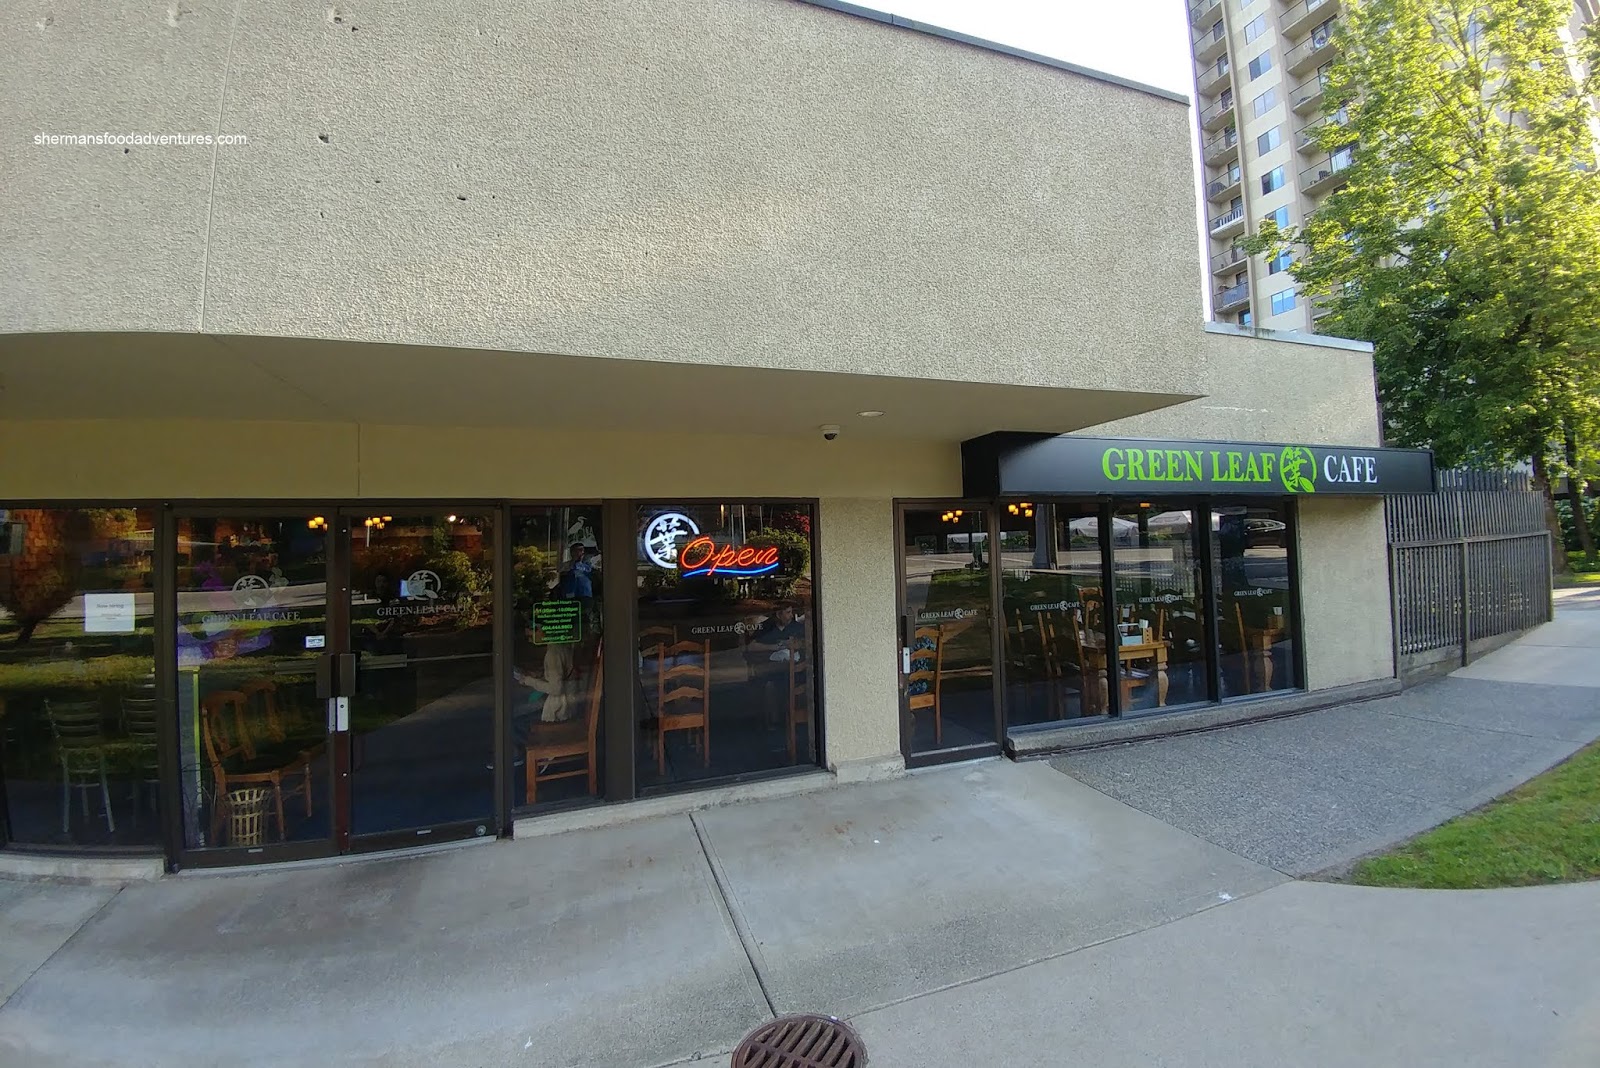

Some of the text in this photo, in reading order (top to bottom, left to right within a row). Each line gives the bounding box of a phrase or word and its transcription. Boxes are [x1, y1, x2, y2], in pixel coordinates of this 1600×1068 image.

[1102, 447, 1276, 482] GREEN LEAF
[1323, 455, 1378, 484] CAFE
[681, 536, 779, 576] Open
[272, 611, 301, 621] CAFE
[376, 606, 414, 617] GREEN
[921, 611, 940, 619] GREEN
[941, 610, 955, 618] LEAF
[691, 623, 764, 635] GREEN LEAF CAFE
